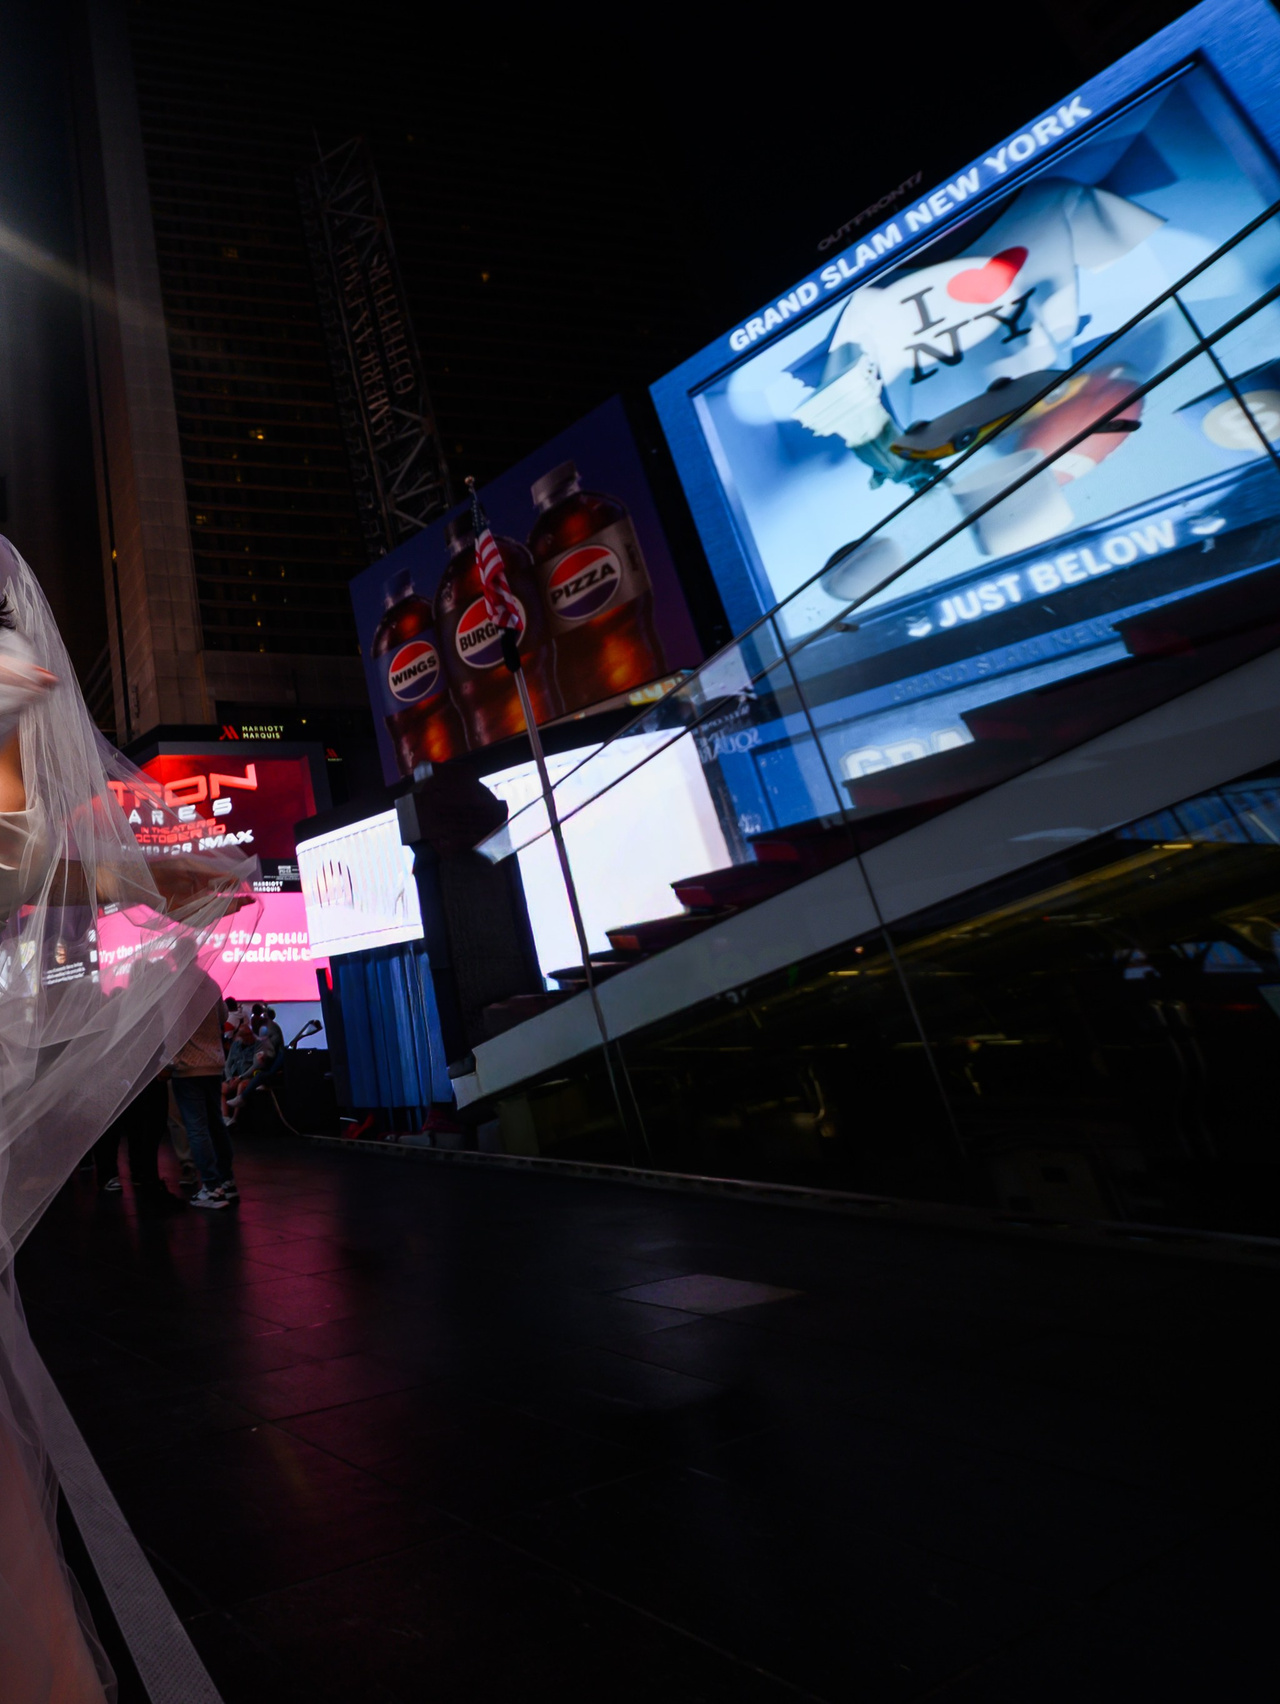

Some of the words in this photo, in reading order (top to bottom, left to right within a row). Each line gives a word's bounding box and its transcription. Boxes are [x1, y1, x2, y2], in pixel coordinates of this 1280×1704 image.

[729, 281, 819, 353] GRAND
[821, 225, 903, 290] SLAM
[907, 168, 982, 234] NEW
[984, 96, 1092, 173] YORK
[900, 285, 946, 336] I
[903, 287, 1038, 386] NY
[549, 562, 616, 606] PIZZA
[938, 574, 1023, 629] JUST
[1028, 520, 1179, 582] BELOW
[459, 621, 499, 652] BURG
[391, 656, 437, 687] WINGS
[242, 732, 282, 740] MARQUIS
[106, 763, 258, 809] TRON
[128, 797, 233, 826] ARES
[140, 826, 150, 835] IN
[151, 818, 217, 834] THEATERS
[136, 829, 203, 844] OCTOBER
[208, 824, 227, 836] 10
[199, 829, 255, 852] IMAX
[229, 929, 262, 945] the
